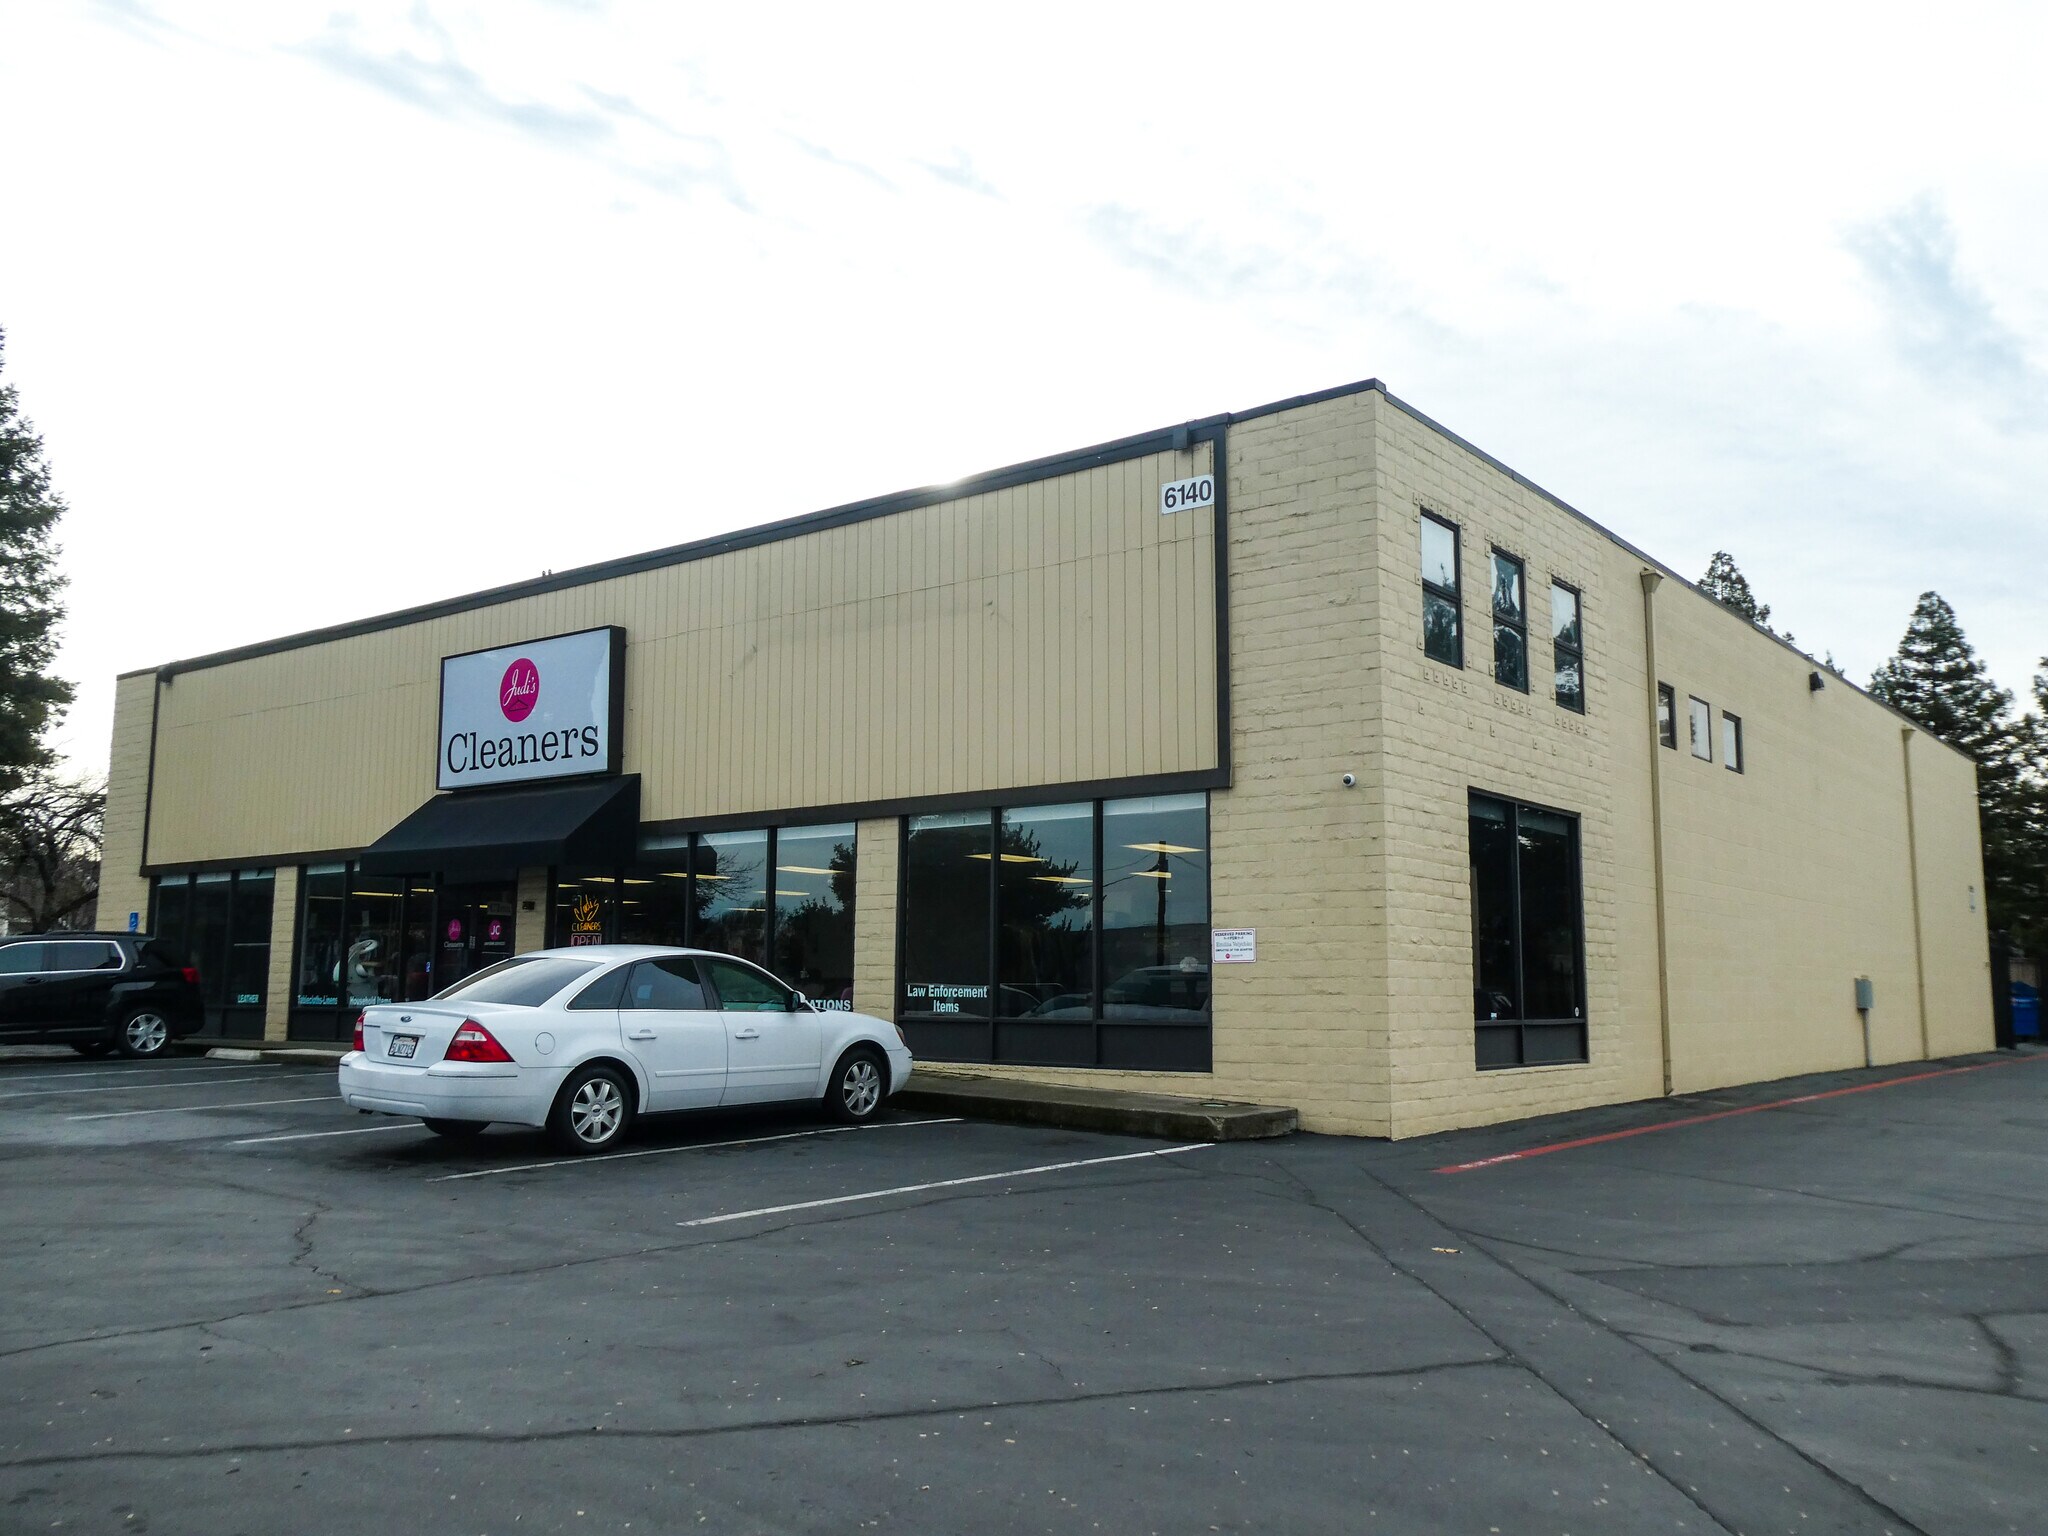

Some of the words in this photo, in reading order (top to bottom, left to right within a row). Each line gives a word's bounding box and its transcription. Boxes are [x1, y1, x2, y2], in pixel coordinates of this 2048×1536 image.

[1164, 479, 1212, 509] 6140
[503, 668, 537, 707] Judi's
[447, 725, 599, 774] Cleaners
[490, 925, 501, 936] JC
[571, 921, 602, 932] CLEANERS
[572, 935, 600, 946] OPEN
[907, 984, 926, 997] Law
[928, 984, 988, 998] Enforcement
[237, 994, 259, 1003] LEATHER
[349, 995, 376, 1006] Household
[376, 996, 392, 1005] Items
[933, 999, 960, 1013] Items
